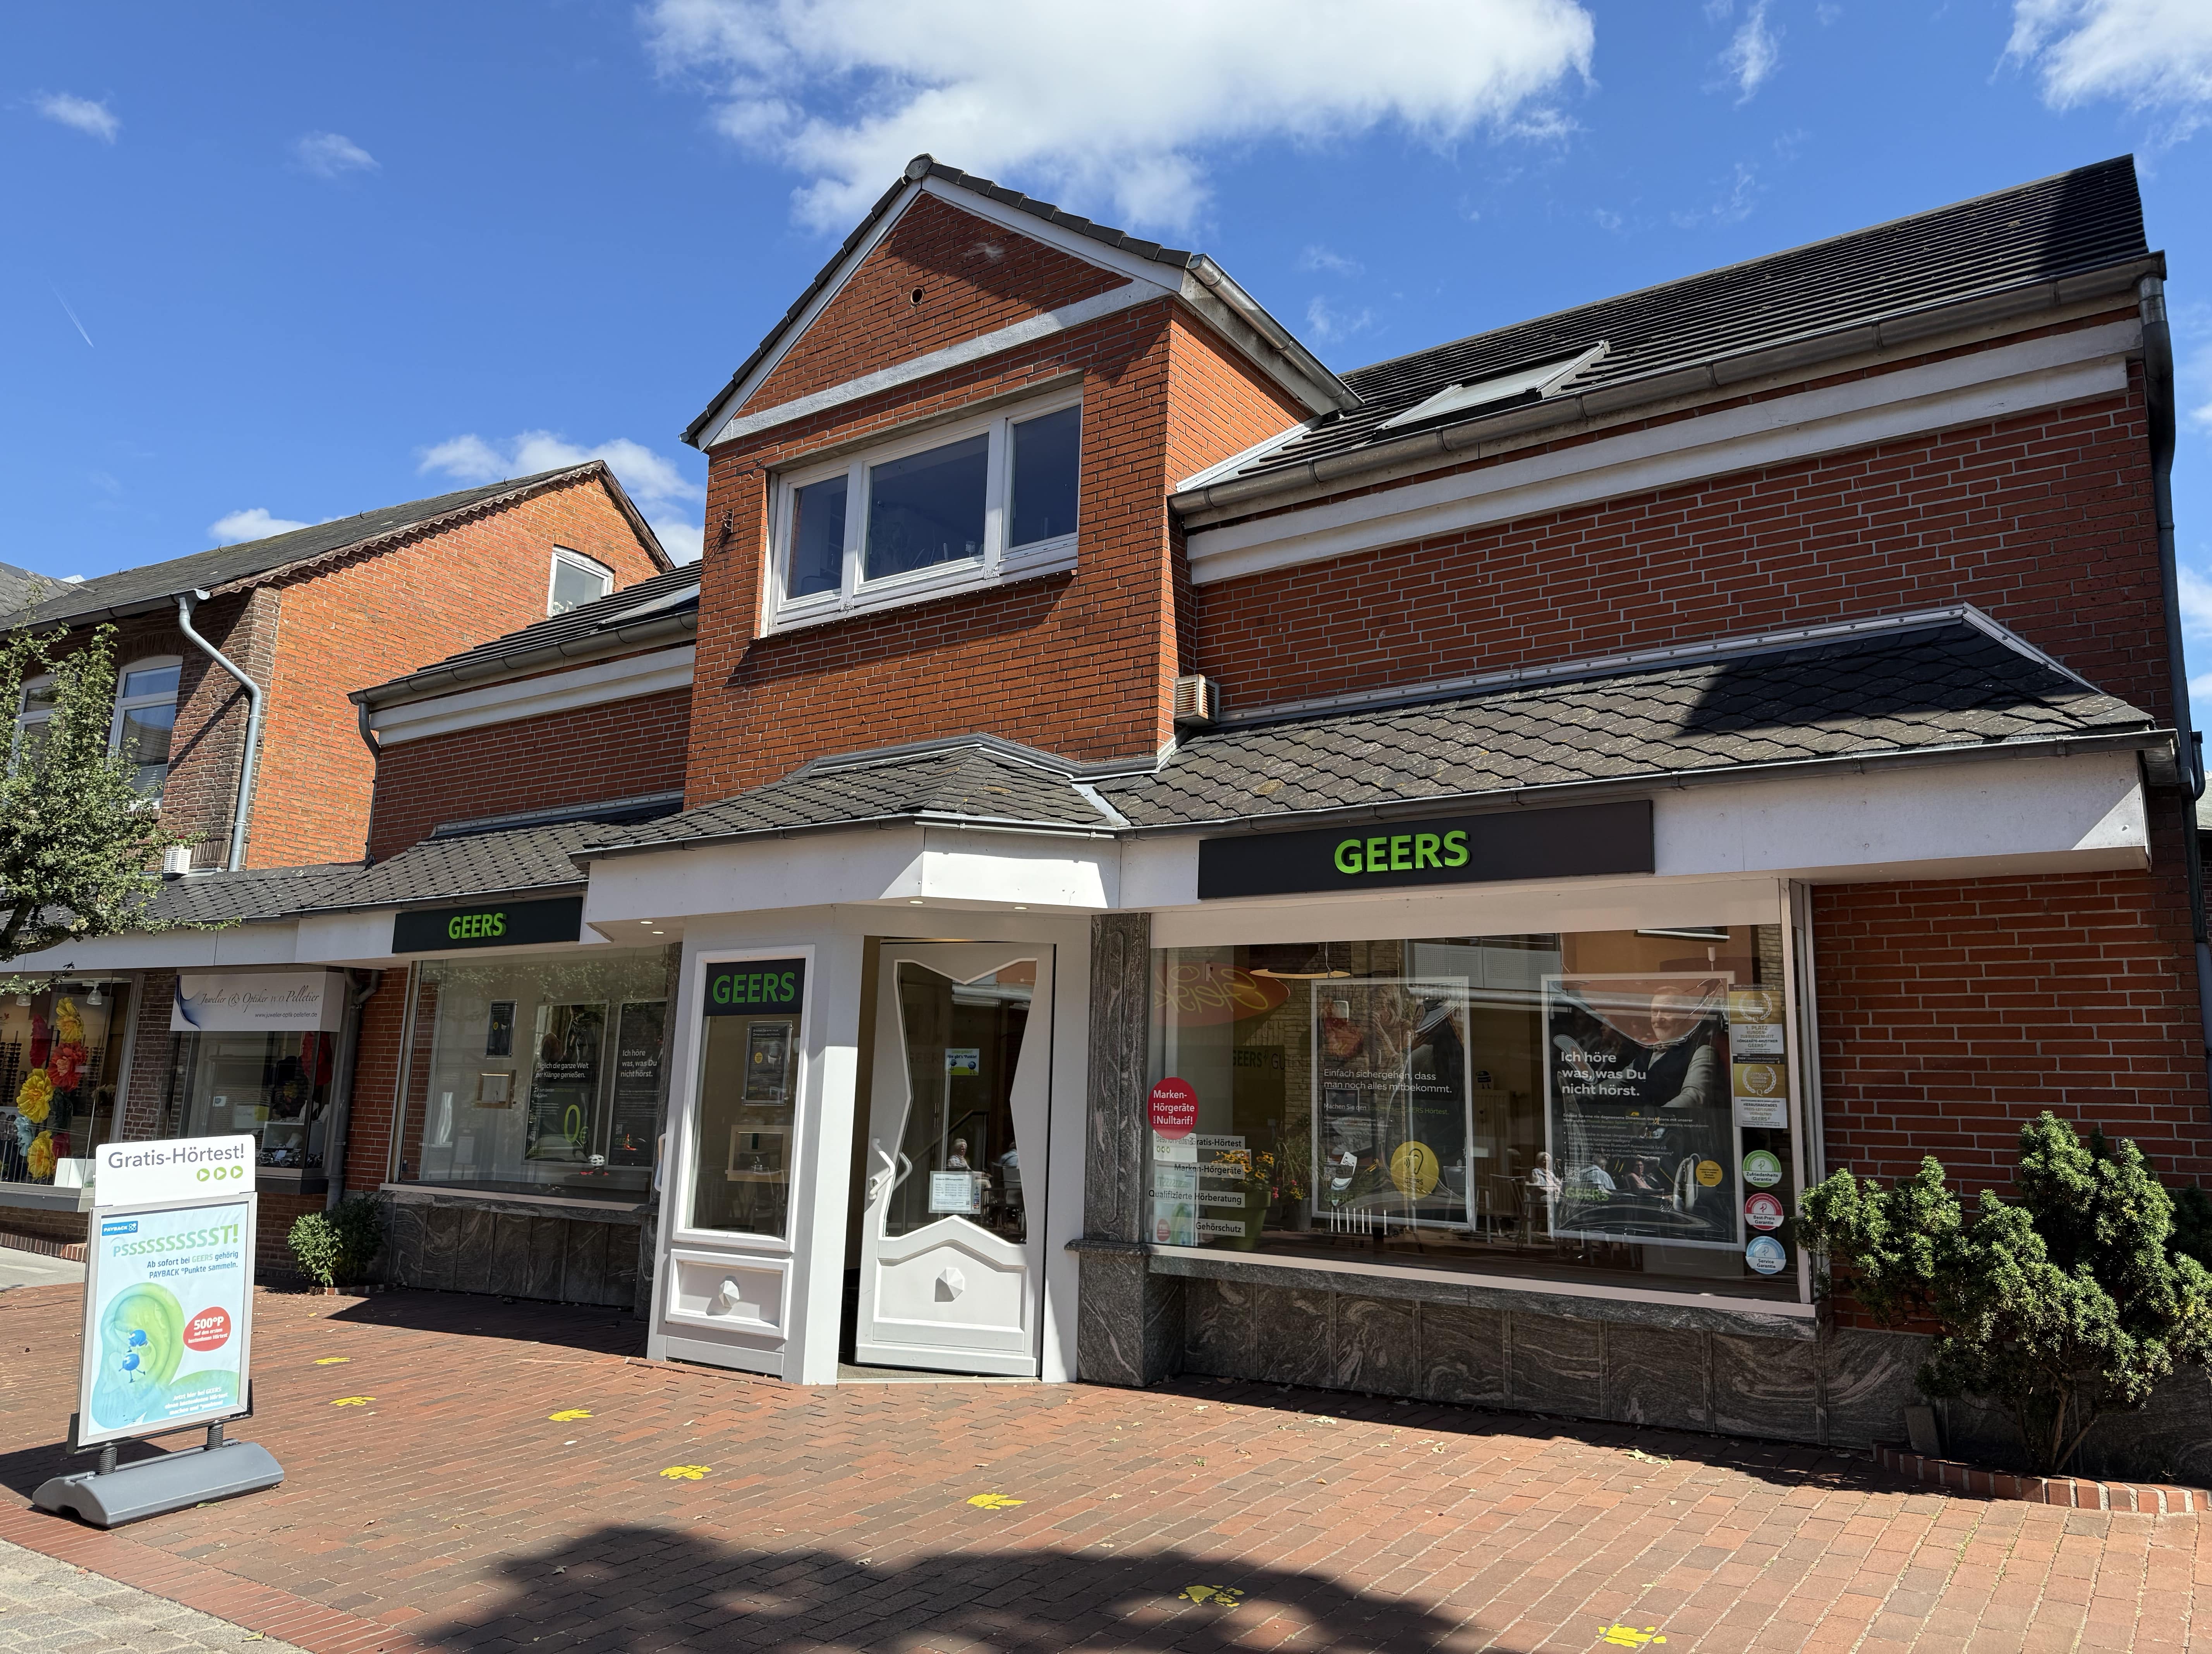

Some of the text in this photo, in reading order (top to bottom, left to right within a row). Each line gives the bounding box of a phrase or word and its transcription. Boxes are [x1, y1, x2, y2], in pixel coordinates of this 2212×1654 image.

[1334, 830, 1470, 875] GEERS
[448, 912, 507, 939] GEERS
[713, 972, 795, 1004] GEERS
[198, 988, 226, 1005] Juwelier
[228, 993, 240, 1007] &
[243, 988, 268, 1013] Optiker
[286, 985, 319, 1002] Pelletier
[1561, 1051, 1616, 1063] Ich höre
[1324, 1069, 1436, 1080] Einfach sichergehen, dass
[1562, 1069, 1646, 1080] was, was Du
[1345, 1081, 1365, 1089] noch
[1367, 1081, 1387, 1090] alles
[1389, 1083, 1452, 1093] mitbekommt.
[1562, 1083, 1640, 1096] nicht hörst.
[1153, 1090, 1187, 1099] Marken-
[1153, 1102, 1195, 1114] Hörgeräte
[1156, 1115, 1193, 1125] Nulltarif!
[1192, 1137, 1242, 1147] Gratis-Hörtest
[108, 1143, 244, 1168] Gratis-Hörtest!
[1174, 1163, 1242, 1175] Marken-Hörgeräte
[1149, 1189, 1242, 1205] Qualifizierte Hörberatung
[1565, 1187, 1609, 1201] GEERS
[1195, 1221, 1242, 1233] Gehörschutz
[157, 1258, 179, 1268] sofort
[192, 1254, 213, 1263] GEERS
[215, 1251, 239, 1261] gehörig
[149, 1261, 238, 1278] PAYBACK °Punkte sammeln.
[193, 1316, 224, 1330] 500°P
